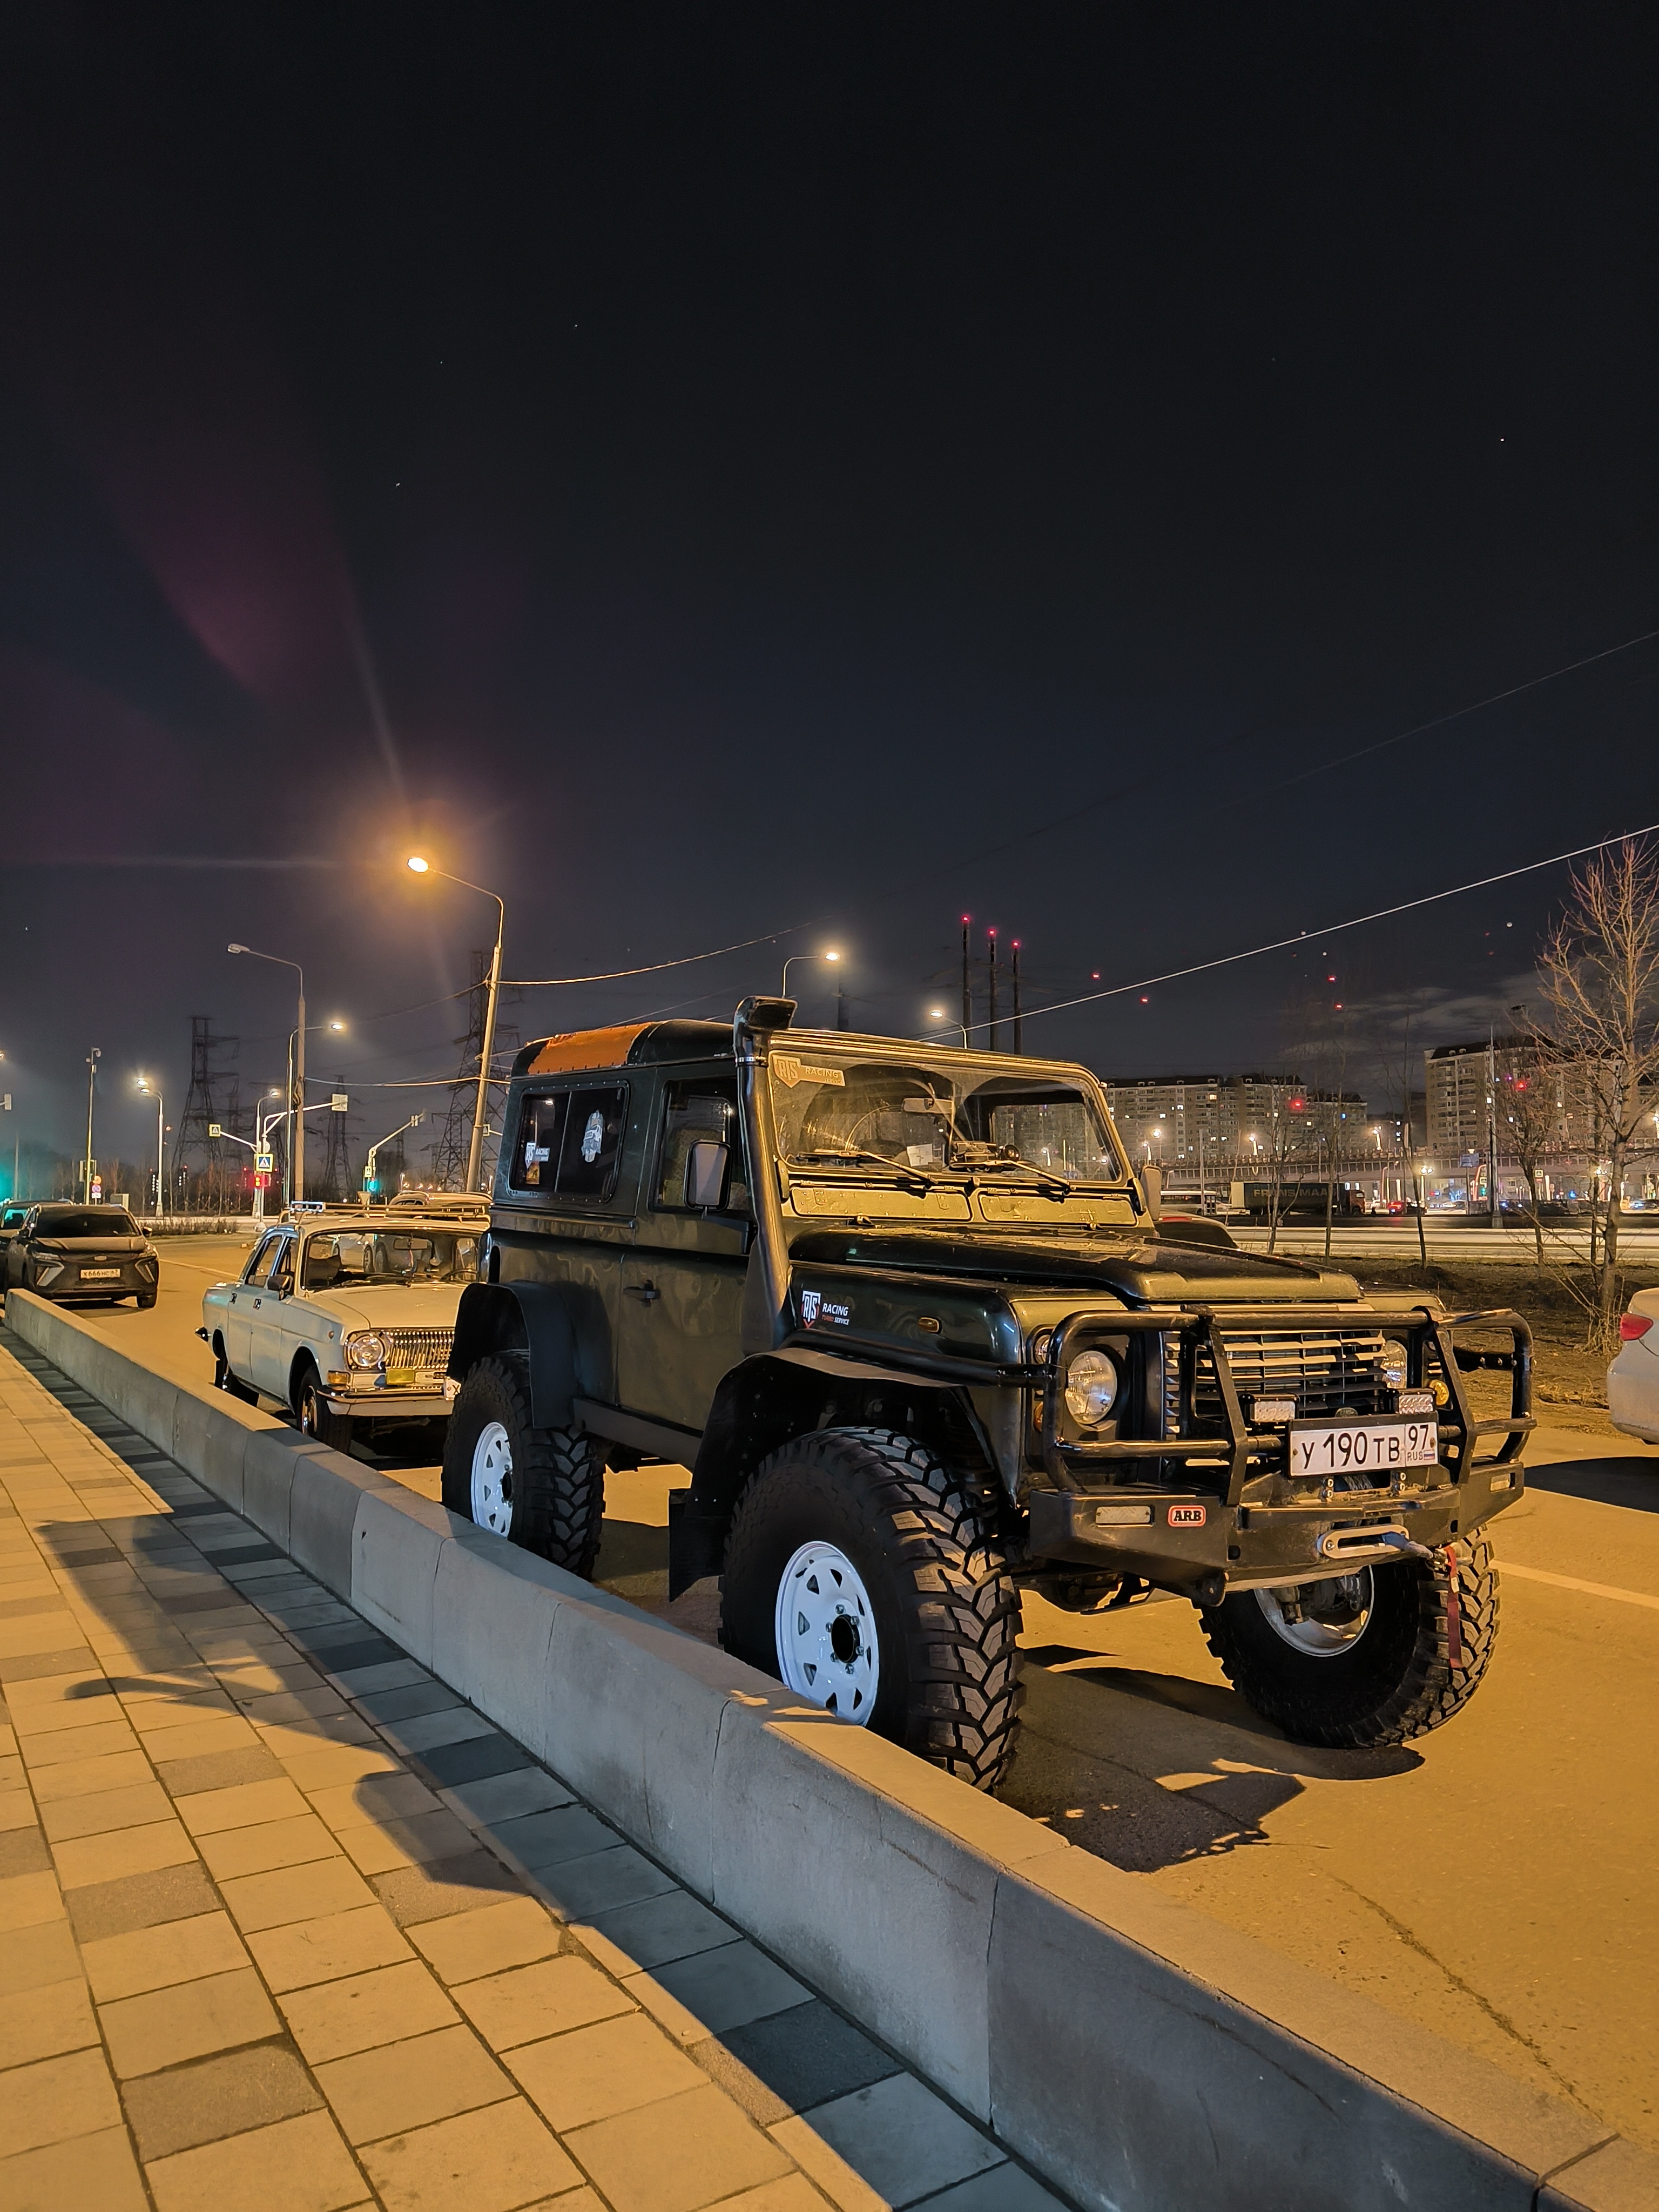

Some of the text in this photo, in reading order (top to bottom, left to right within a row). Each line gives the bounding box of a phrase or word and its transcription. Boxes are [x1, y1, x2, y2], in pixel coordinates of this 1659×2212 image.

[805, 1067, 839, 1078] RACING
[802, 1290, 821, 1323] RTS
[822, 1303, 849, 1317] RACING
[1408, 1424, 1429, 1451] 97
[1407, 1451, 1424, 1461] RUS
[1174, 1510, 1202, 1521] ARB
